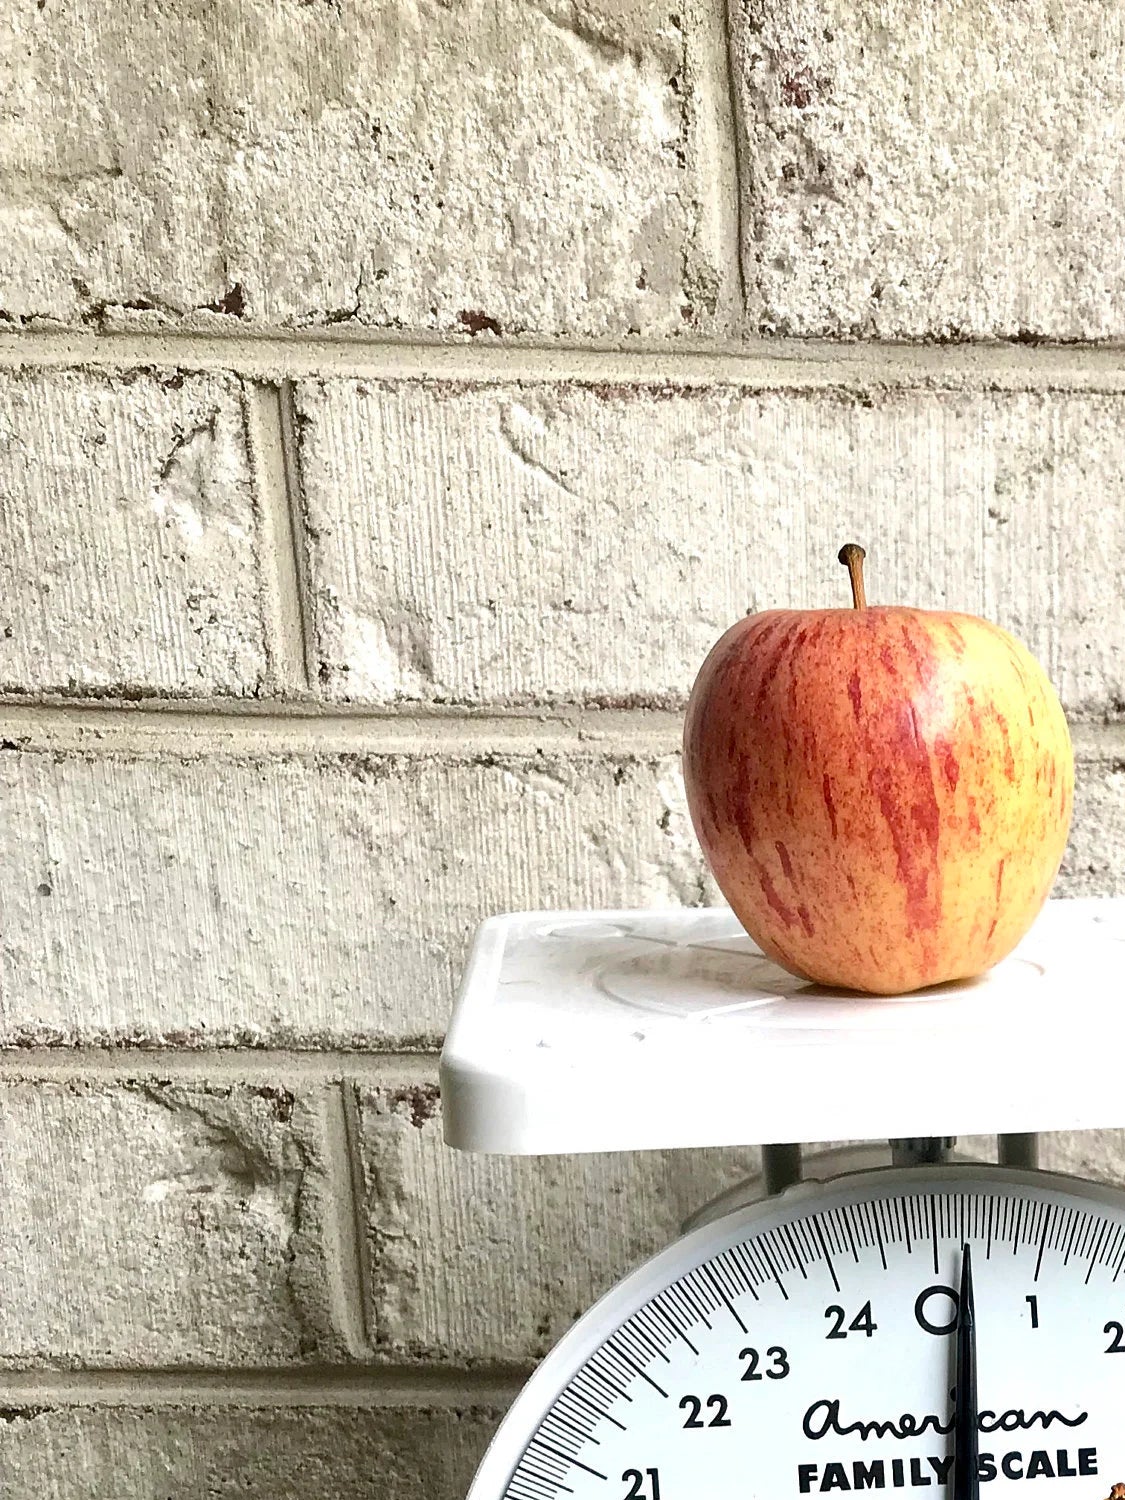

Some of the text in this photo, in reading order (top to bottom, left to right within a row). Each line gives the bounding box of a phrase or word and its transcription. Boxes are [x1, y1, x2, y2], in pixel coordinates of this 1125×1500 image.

[824, 1299, 878, 1340] 24
[1025, 1294, 1039, 1329] 1
[738, 1345, 790, 1382] 23
[678, 1393, 732, 1429] 22
[797, 1447, 1099, 1493] FAMILY SCALE
